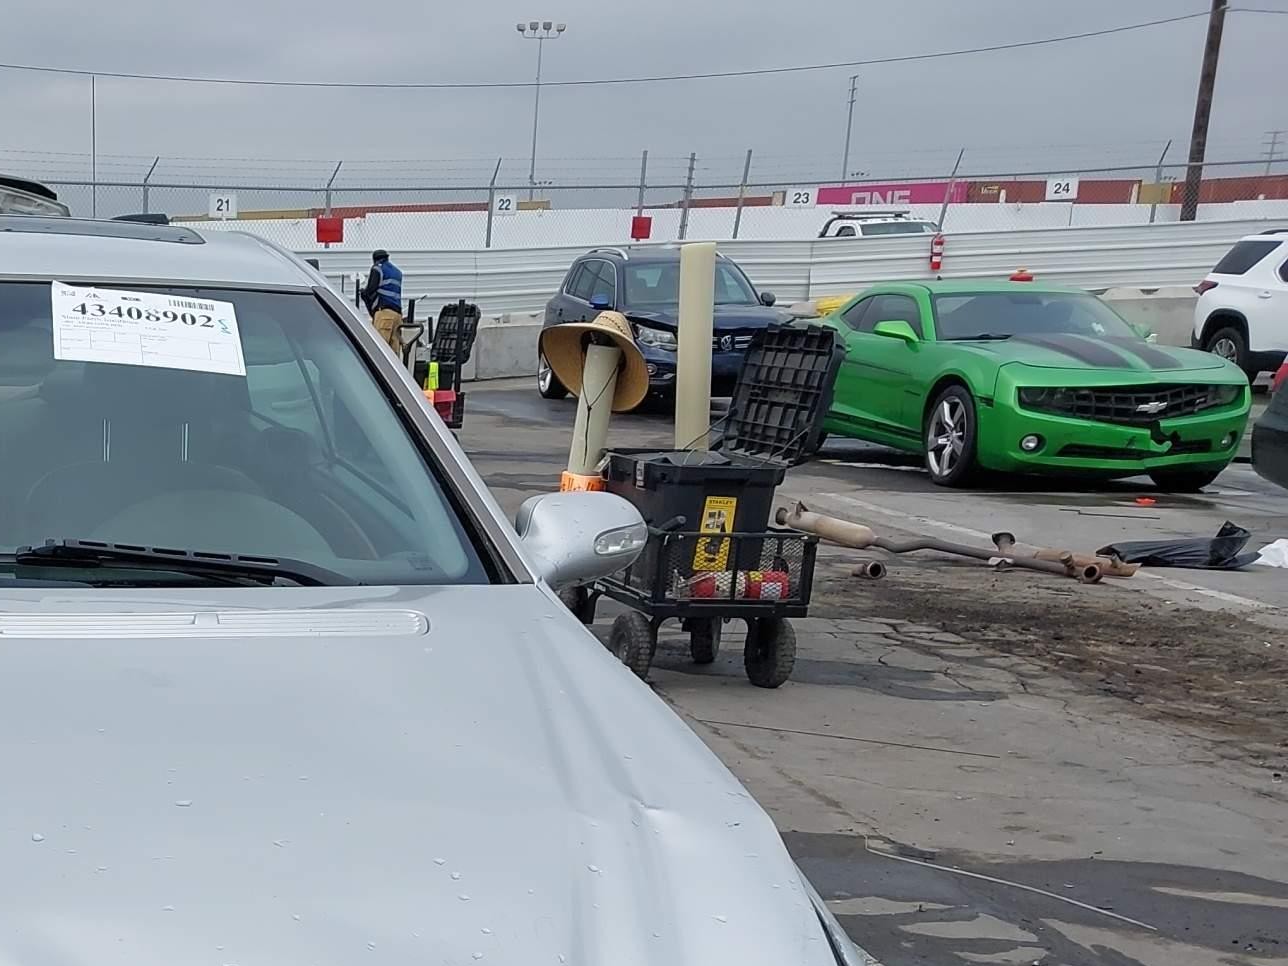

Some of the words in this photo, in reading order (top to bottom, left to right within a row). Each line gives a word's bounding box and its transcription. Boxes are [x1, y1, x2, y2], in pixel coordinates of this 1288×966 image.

[1053, 182, 1070, 195] 24
[216, 198, 230, 211] 21
[498, 198, 511, 211] 22
[792, 192, 810, 205] 23
[72, 302, 215, 329] 43408902
